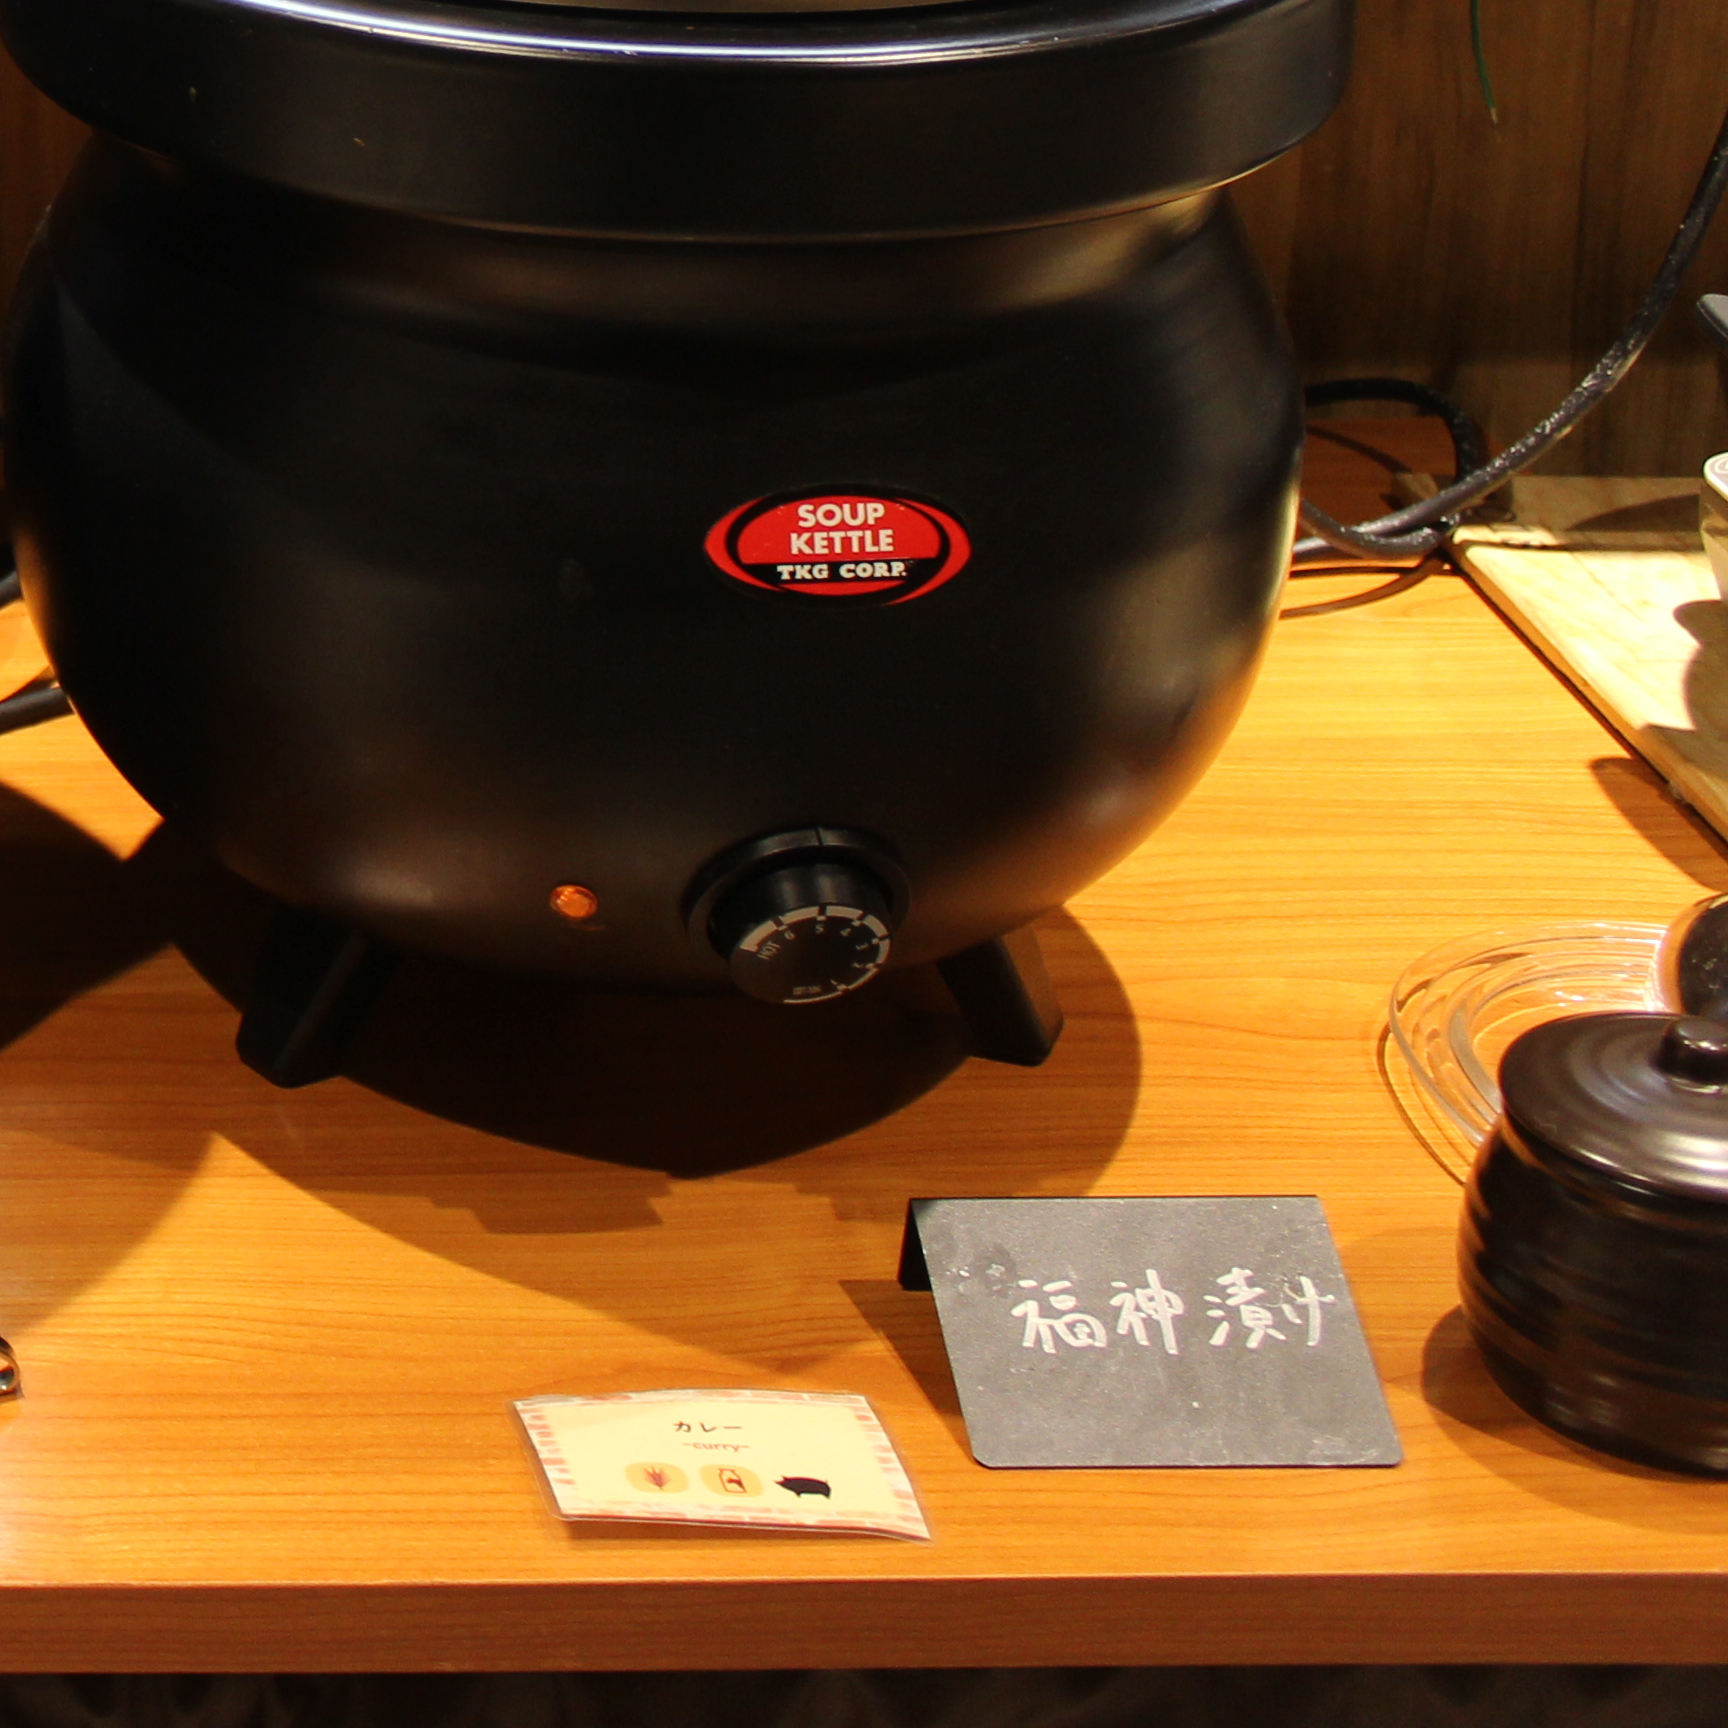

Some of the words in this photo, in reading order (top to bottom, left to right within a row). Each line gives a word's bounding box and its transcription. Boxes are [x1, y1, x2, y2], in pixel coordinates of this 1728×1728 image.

[796, 502, 886, 527] SOUP
[790, 528, 894, 555] KETTLE
[777, 563, 830, 580] TKG
[839, 561, 907, 579] CORP.
[1010, 1267, 1335, 1355] 福神漬け
[673, 1420, 742, 1433] カレー
